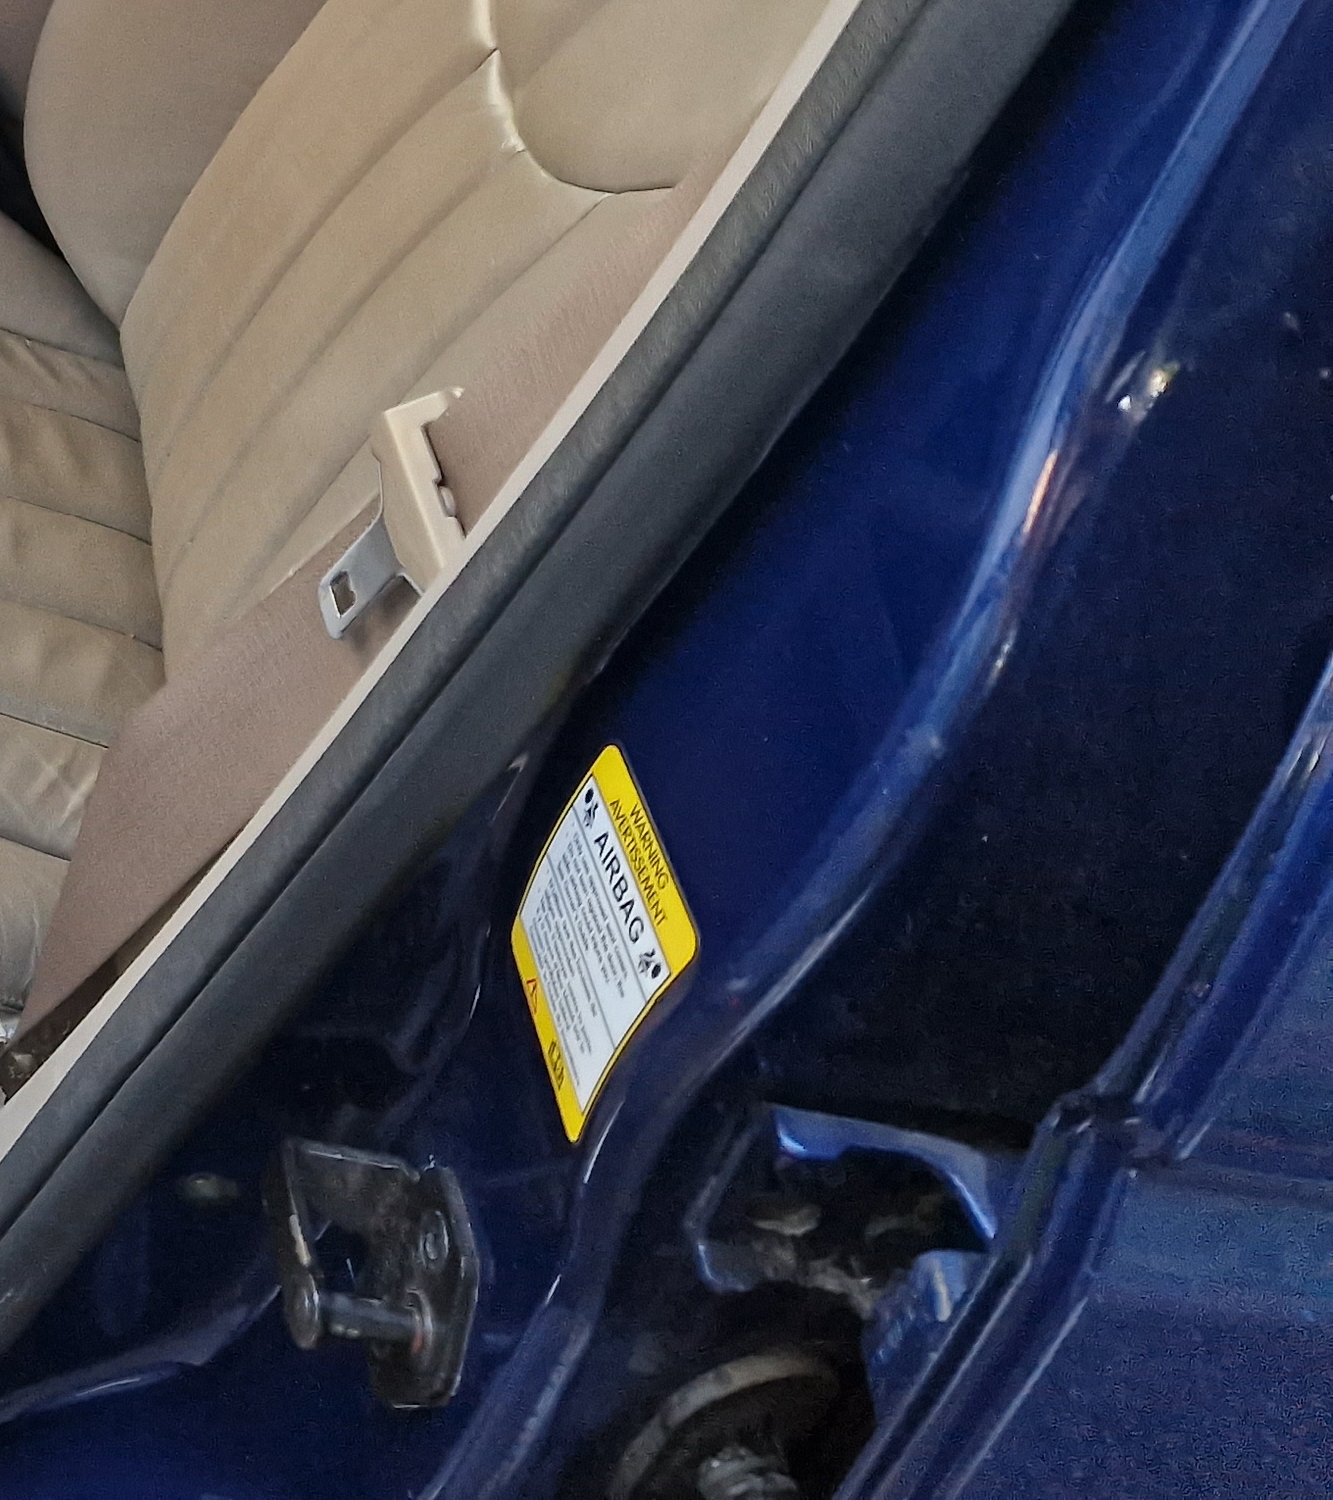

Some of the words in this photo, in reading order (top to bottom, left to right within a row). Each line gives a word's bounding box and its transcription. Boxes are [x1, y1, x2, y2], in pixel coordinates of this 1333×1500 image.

[594, 831, 644, 944] AIRBAG
[609, 798, 668, 926] AVERTISSEMENT
[630, 802, 669, 890] WARNING
